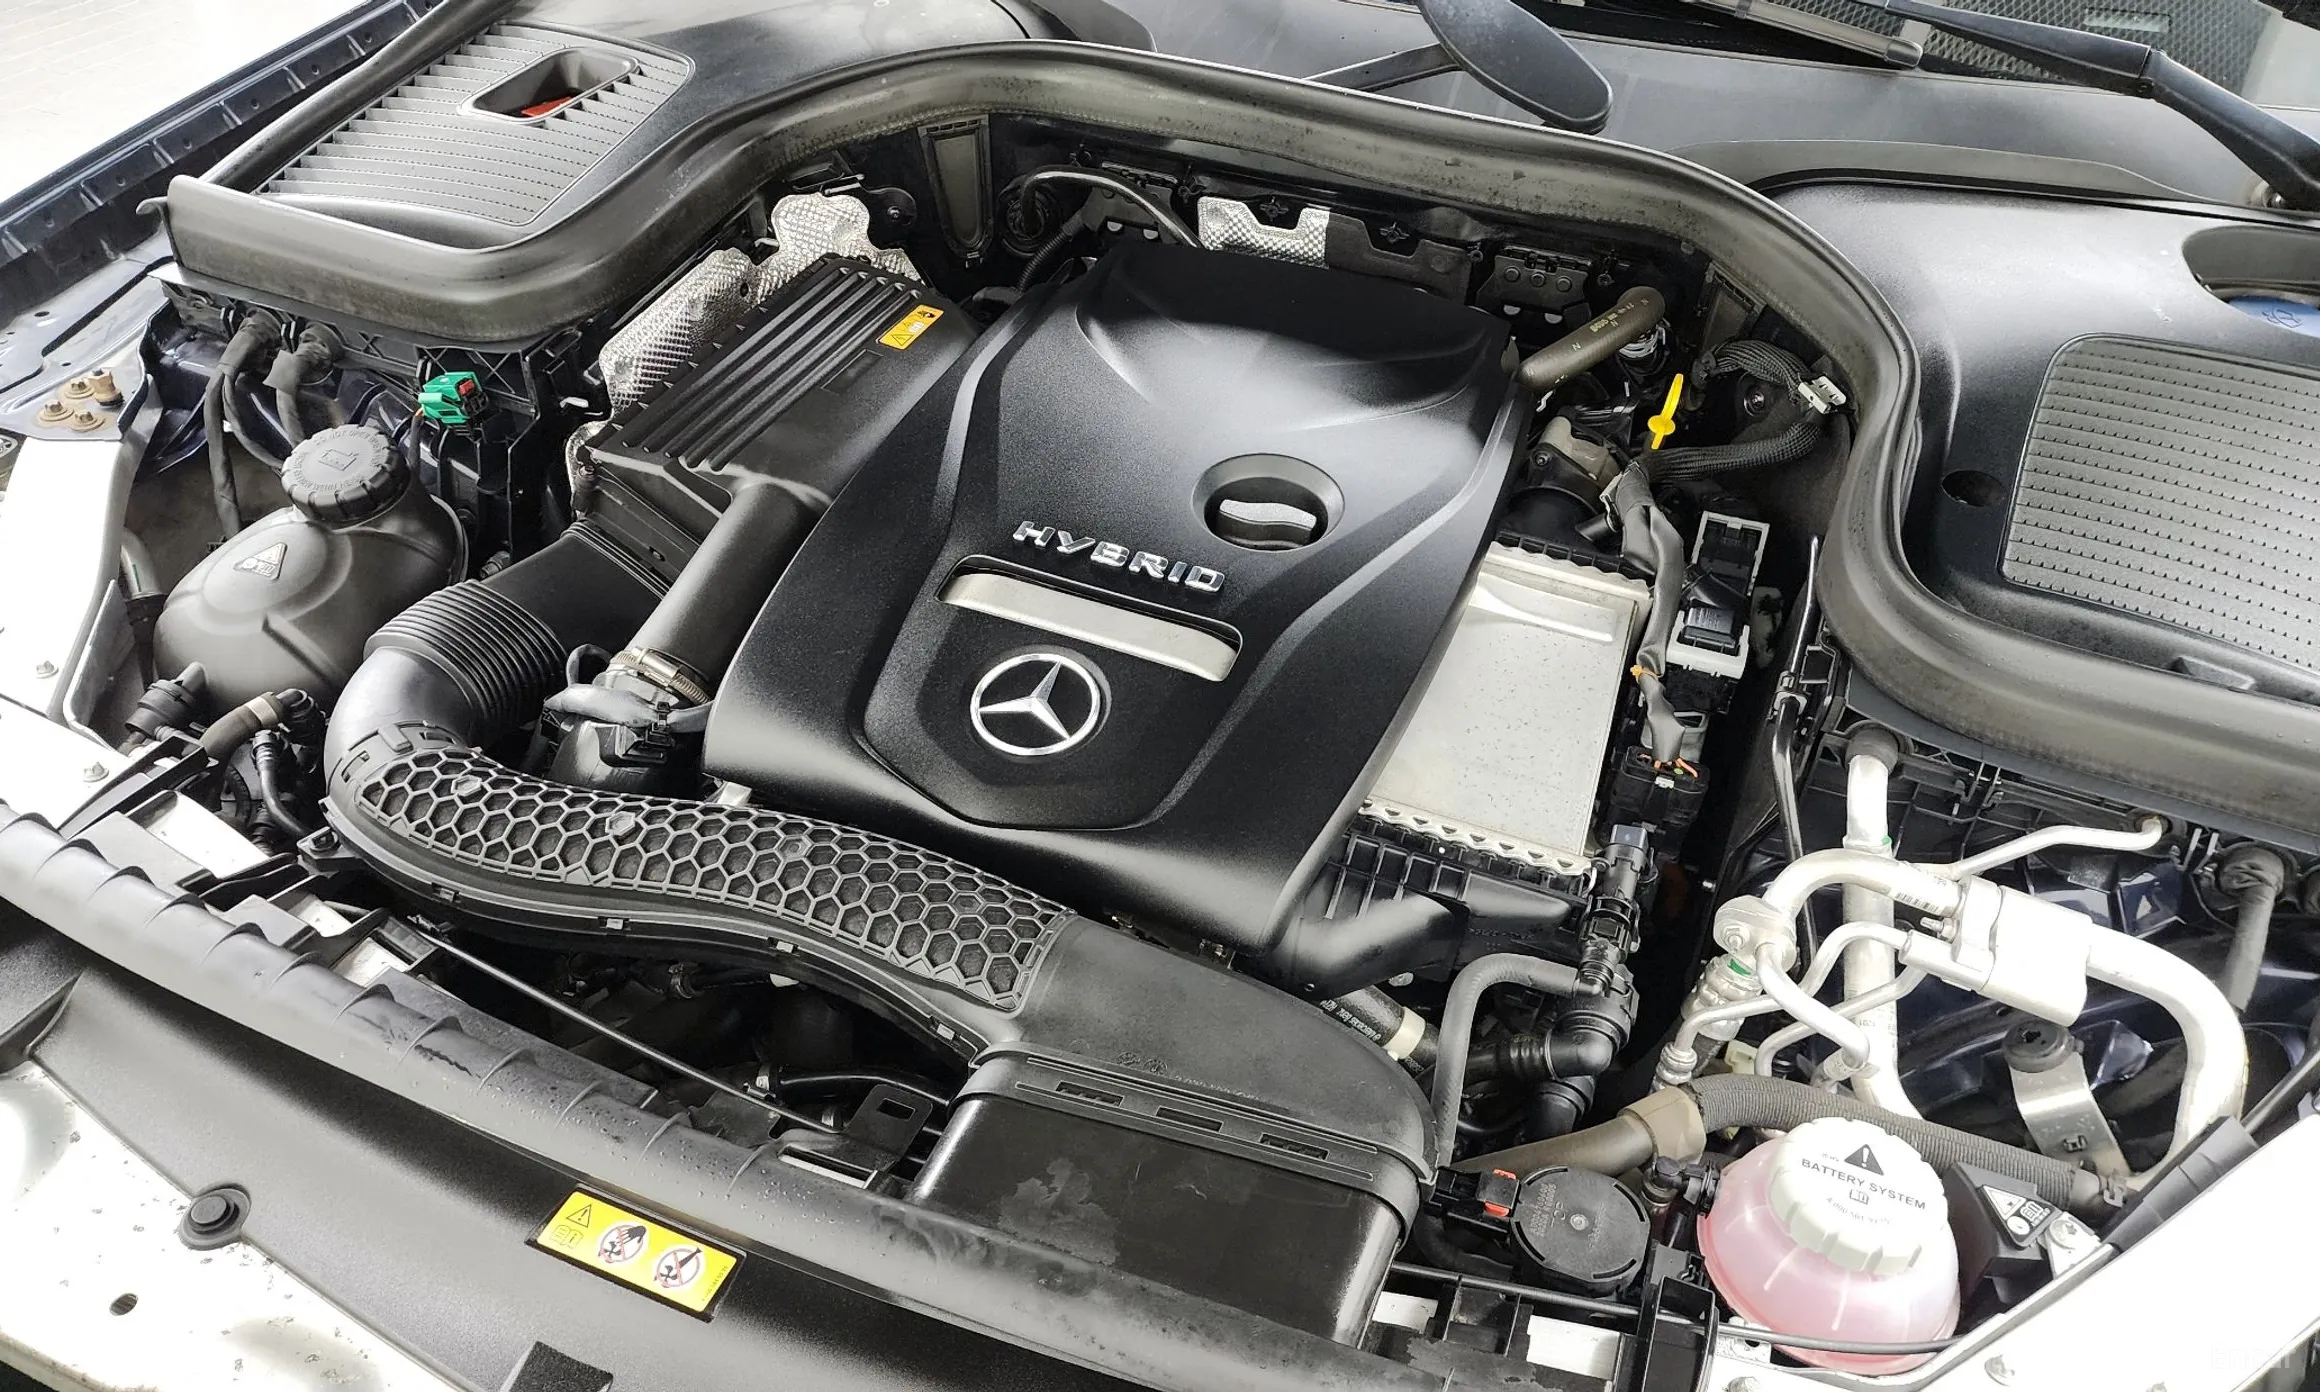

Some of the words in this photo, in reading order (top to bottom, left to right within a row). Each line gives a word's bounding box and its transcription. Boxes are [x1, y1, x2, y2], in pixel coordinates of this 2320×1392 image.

[1012, 520, 1225, 592] HYBRID
[1801, 1158, 1865, 1187] BATTERY
[1869, 1182, 1926, 1210] SYSTEM
